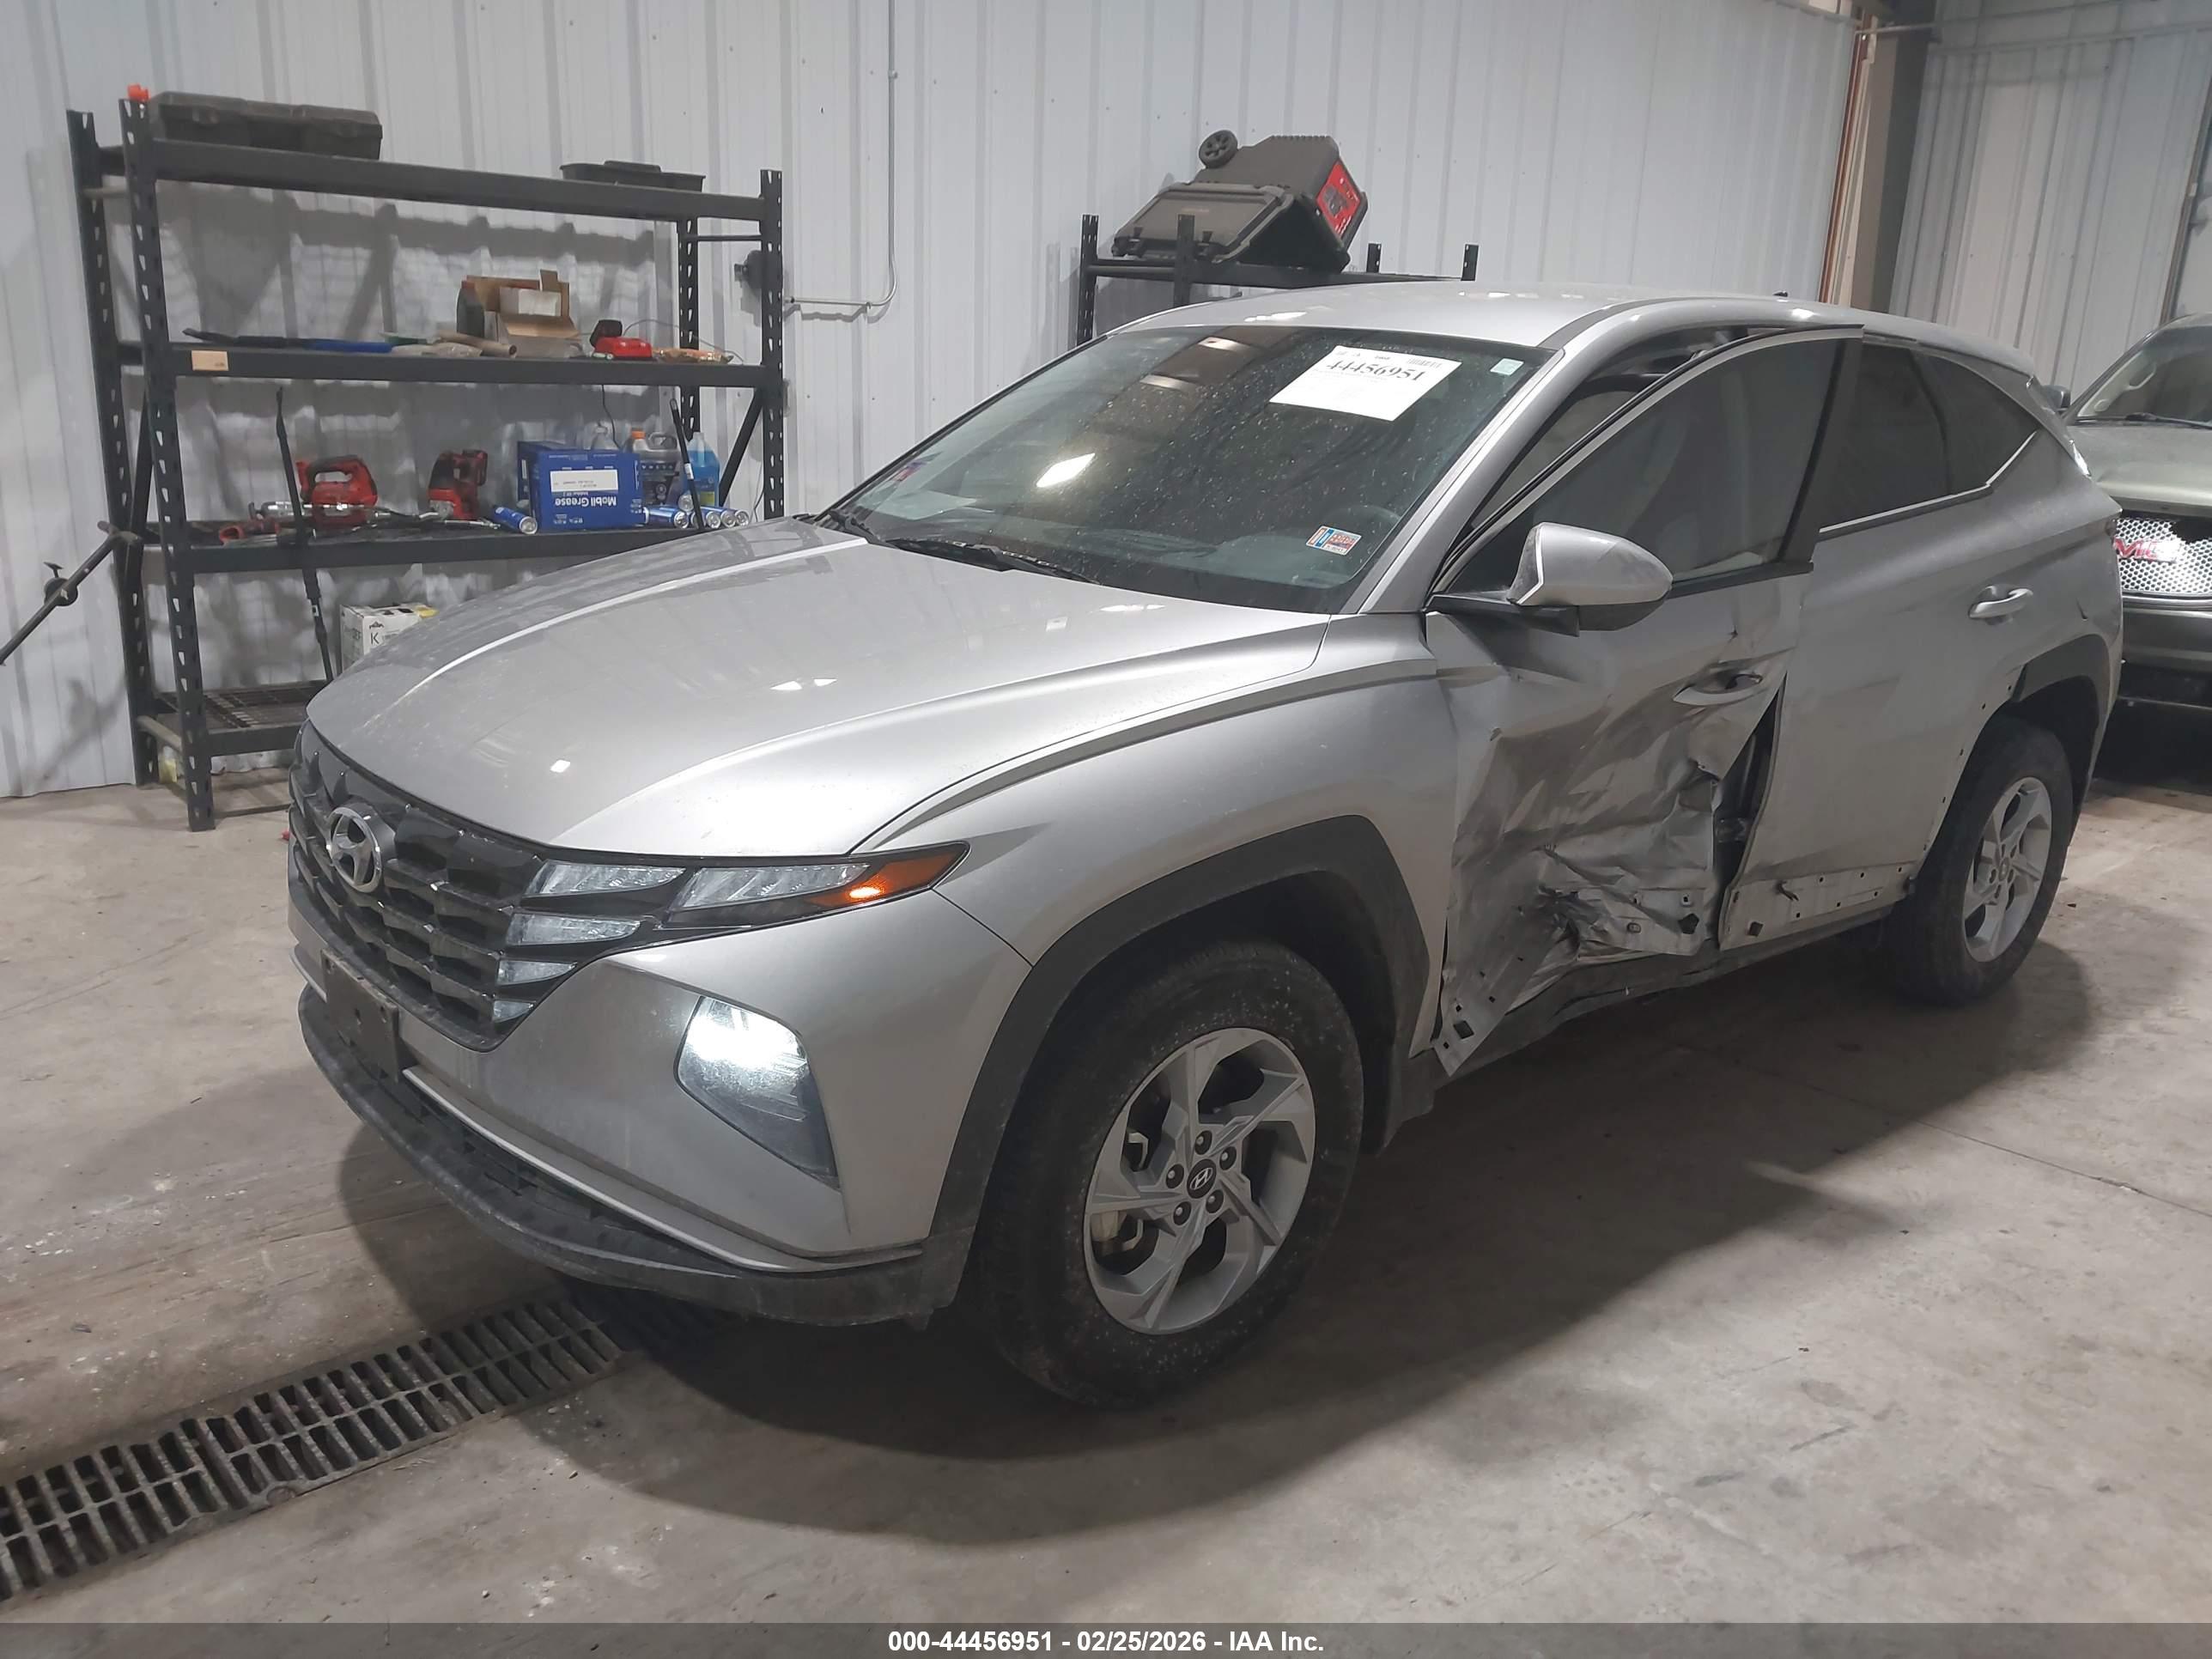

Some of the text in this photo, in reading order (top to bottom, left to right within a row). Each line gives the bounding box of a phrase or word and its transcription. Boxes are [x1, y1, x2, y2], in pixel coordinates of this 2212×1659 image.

[1327, 360, 1425, 380] 44456951
[555, 495, 617, 507] Mobil Grease
